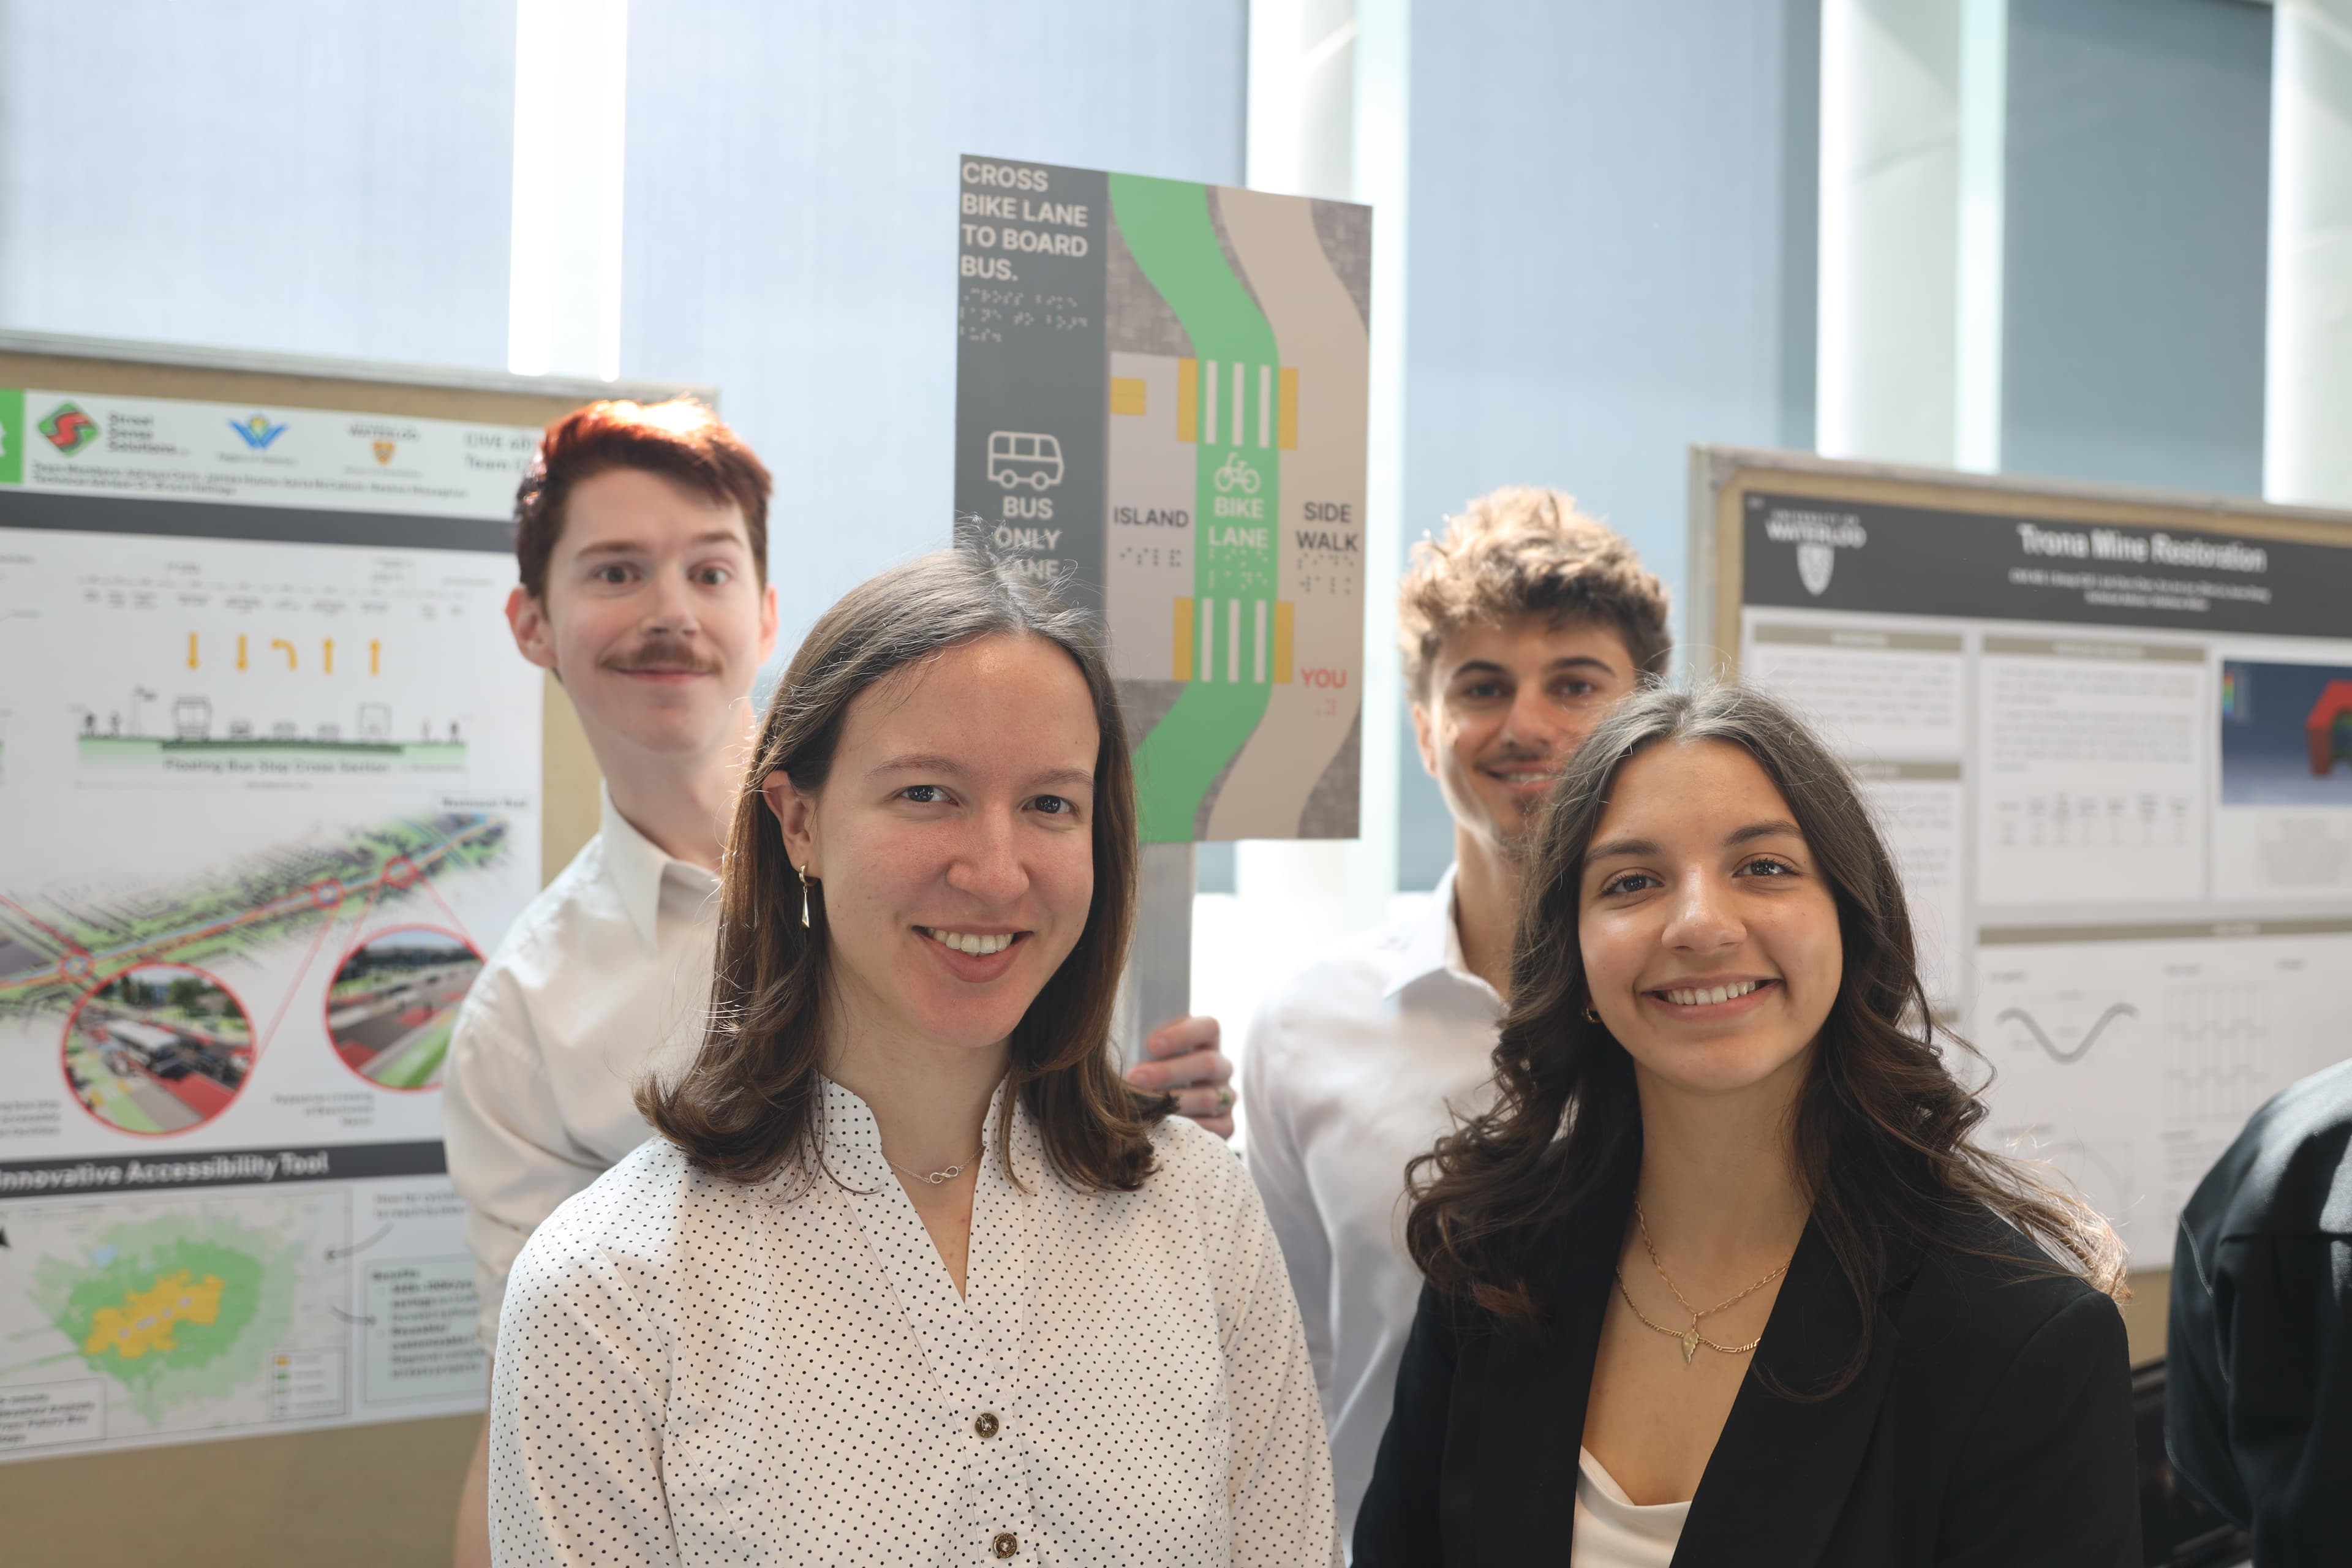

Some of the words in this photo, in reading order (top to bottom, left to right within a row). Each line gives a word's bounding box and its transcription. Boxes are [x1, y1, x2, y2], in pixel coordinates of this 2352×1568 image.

[962, 161, 1049, 192] CROSS
[962, 192, 1017, 219] BIKE
[1022, 199, 1088, 227] LANE
[960, 223, 997, 247] TO
[1002, 228, 1088, 257] BOARD
[960, 255, 1019, 282] BUS.
[1002, 495, 1054, 519] BUS
[1114, 507, 1189, 528] ISLAND
[1215, 496, 1265, 519] BIKE
[1304, 501, 1352, 523] SIDE
[995, 525, 1062, 550] ONLY
[1208, 526, 1268, 549] LANE
[1295, 530, 1359, 552] WALK
[2090, 528, 2149, 562] Mine
[2150, 532, 2267, 573] Restoration
[1000, 556, 1060, 580] ANE
[1300, 668, 1347, 689] YOU
[0, 1162, 123, 1191] nnovative
[125, 1153, 278, 1185] Accessibility
[279, 1150, 330, 1176] Tool
